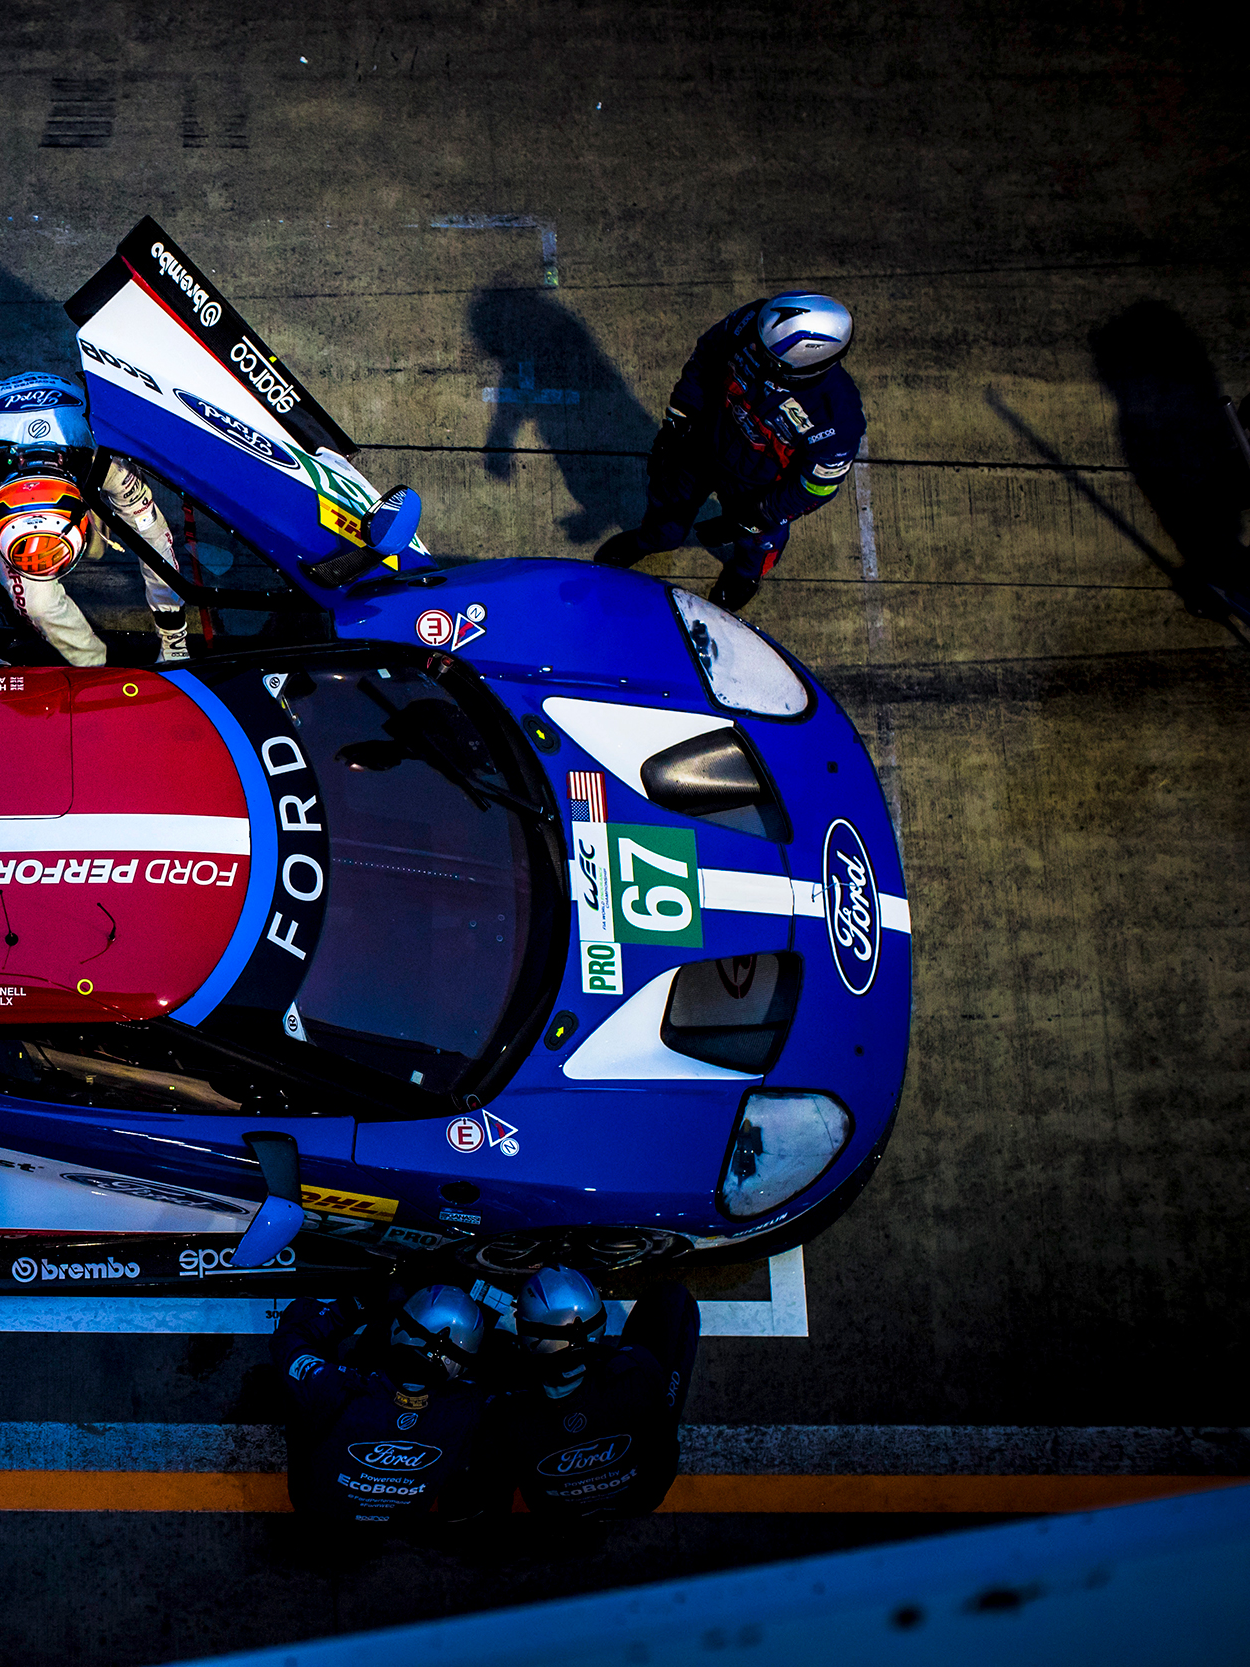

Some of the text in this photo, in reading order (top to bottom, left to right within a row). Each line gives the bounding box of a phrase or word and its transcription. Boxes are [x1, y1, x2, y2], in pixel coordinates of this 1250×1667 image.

[150, 242, 210, 314] brembo
[79, 339, 163, 395] EcoB
[230, 340, 296, 414] sparco
[4, 389, 63, 409] Ford
[198, 400, 273, 456] Ford
[808, 428, 836, 445] sparco
[331, 508, 364, 541] HL
[426, 617, 443, 636] E
[261, 735, 324, 961] FORD
[145, 859, 239, 887] FORD
[578, 838, 600, 911] WEC
[617, 837, 693, 932] 67
[832, 850, 872, 962] Ford
[587, 944, 617, 991] PRO
[457, 1126, 474, 1145] E
[301, 1190, 379, 1215] DHL
[388, 1228, 439, 1246] PRO
[41, 1257, 141, 1281] brembo
[178, 1247, 296, 1278] spao
[665, 1370, 681, 1407] ORD
[365, 1443, 426, 1467] Ford
[557, 1443, 616, 1473] Ford
[337, 1472, 427, 1496] EcoBoost
[360, 1472, 415, 1485] Powered by
[545, 1468, 638, 1497] EcoBoost
[564, 1470, 620, 1488] Powered by
